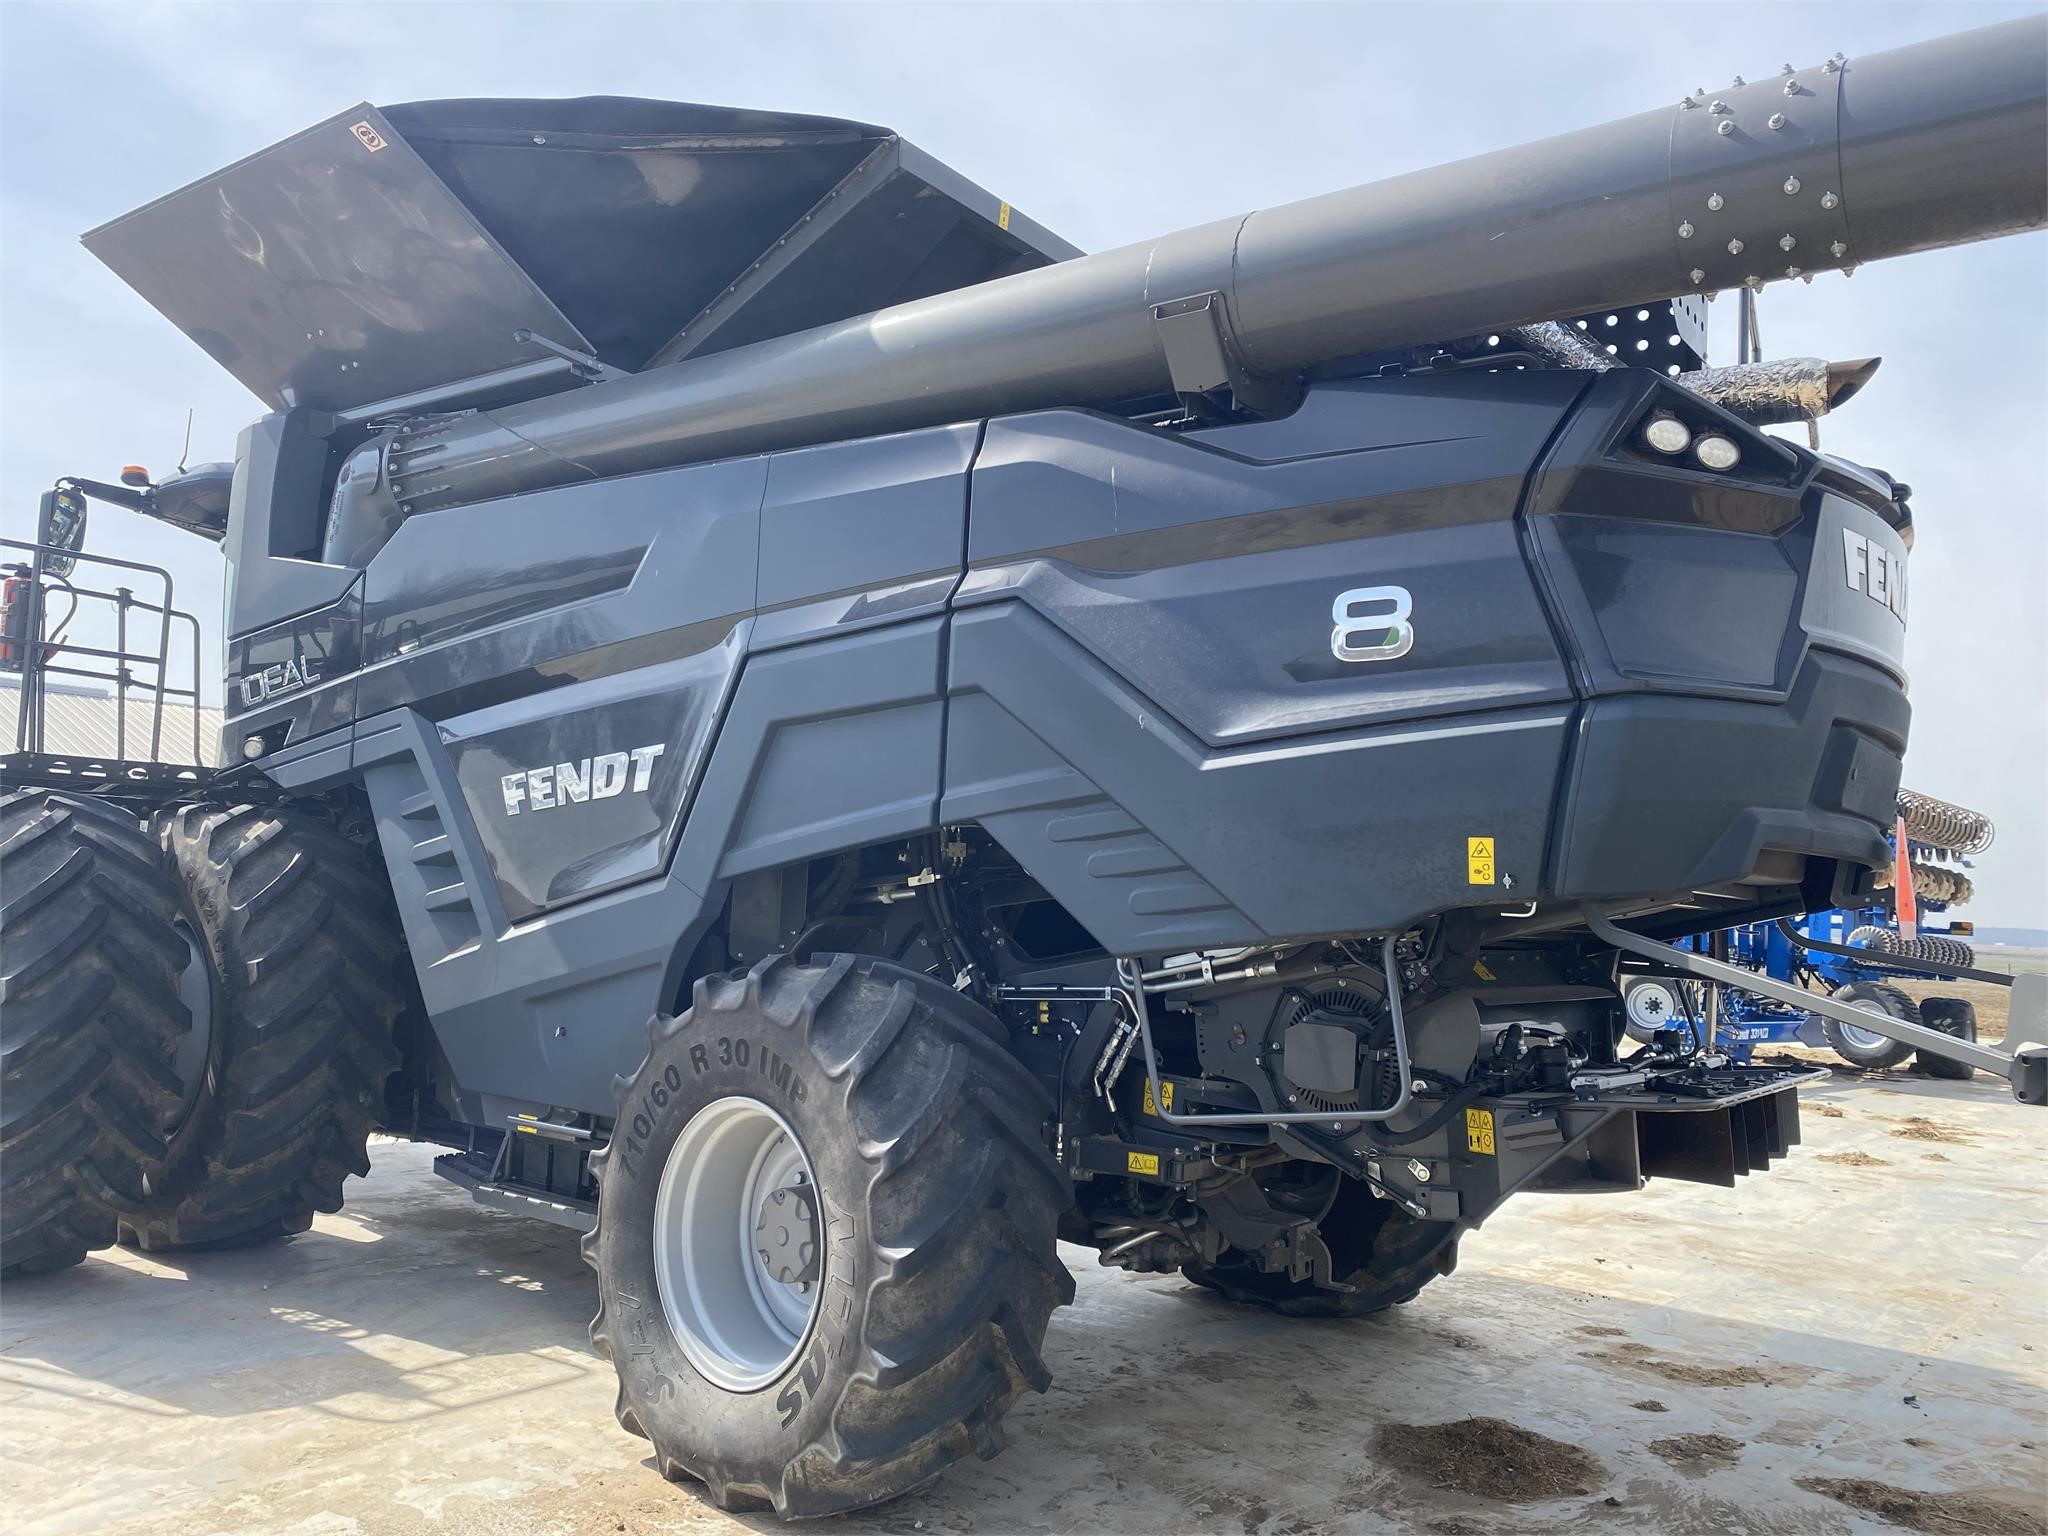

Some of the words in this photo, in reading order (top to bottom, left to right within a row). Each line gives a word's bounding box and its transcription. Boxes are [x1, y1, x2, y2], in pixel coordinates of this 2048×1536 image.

[1331, 585, 1414, 662] 8
[239, 654, 321, 708] IDEAL
[500, 743, 666, 816] FENDT
[618, 1063, 682, 1178] 710/60
[689, 1043, 710, 1075] R
[718, 1037, 750, 1067] 30
[759, 1046, 809, 1105] IMP
